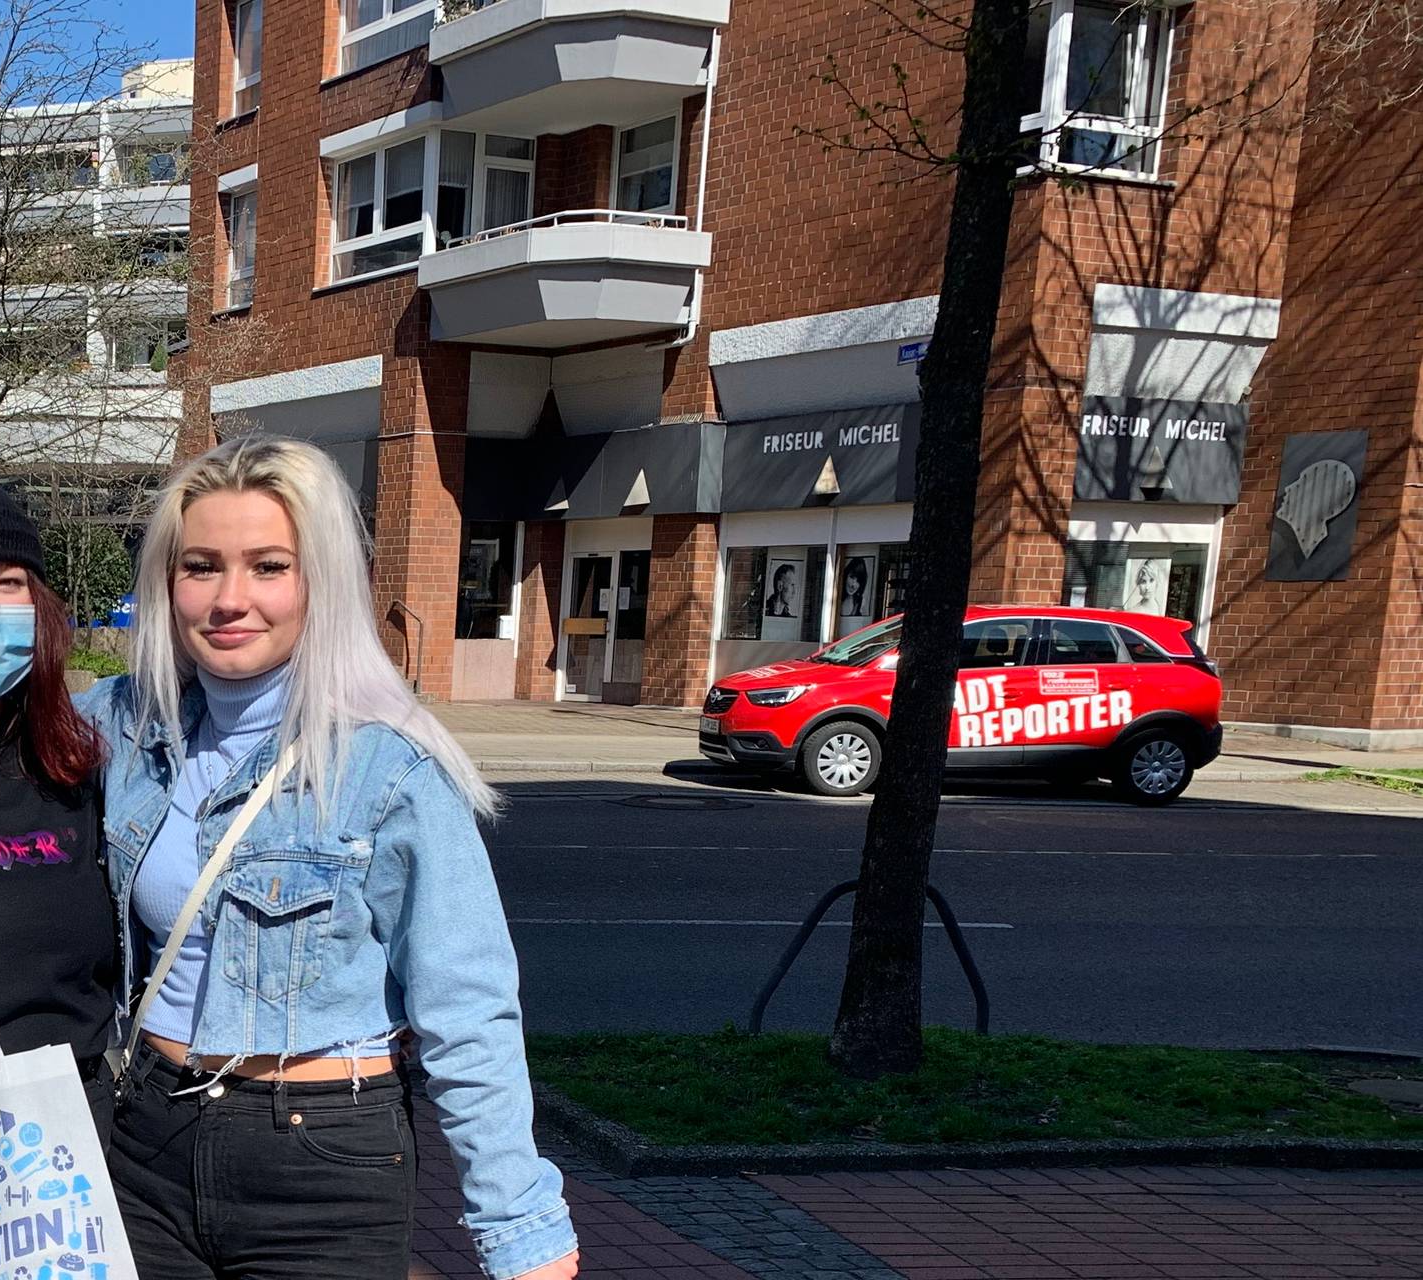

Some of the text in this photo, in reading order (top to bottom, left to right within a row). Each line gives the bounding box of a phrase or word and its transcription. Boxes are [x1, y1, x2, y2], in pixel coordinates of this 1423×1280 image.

[763, 423, 900, 453] FRISEUR MICHEL
[1081, 415, 1227, 441] FRISEUR MICHEL
[953, 675, 1007, 716] ADT
[959, 689, 1133, 747] REPORTER
